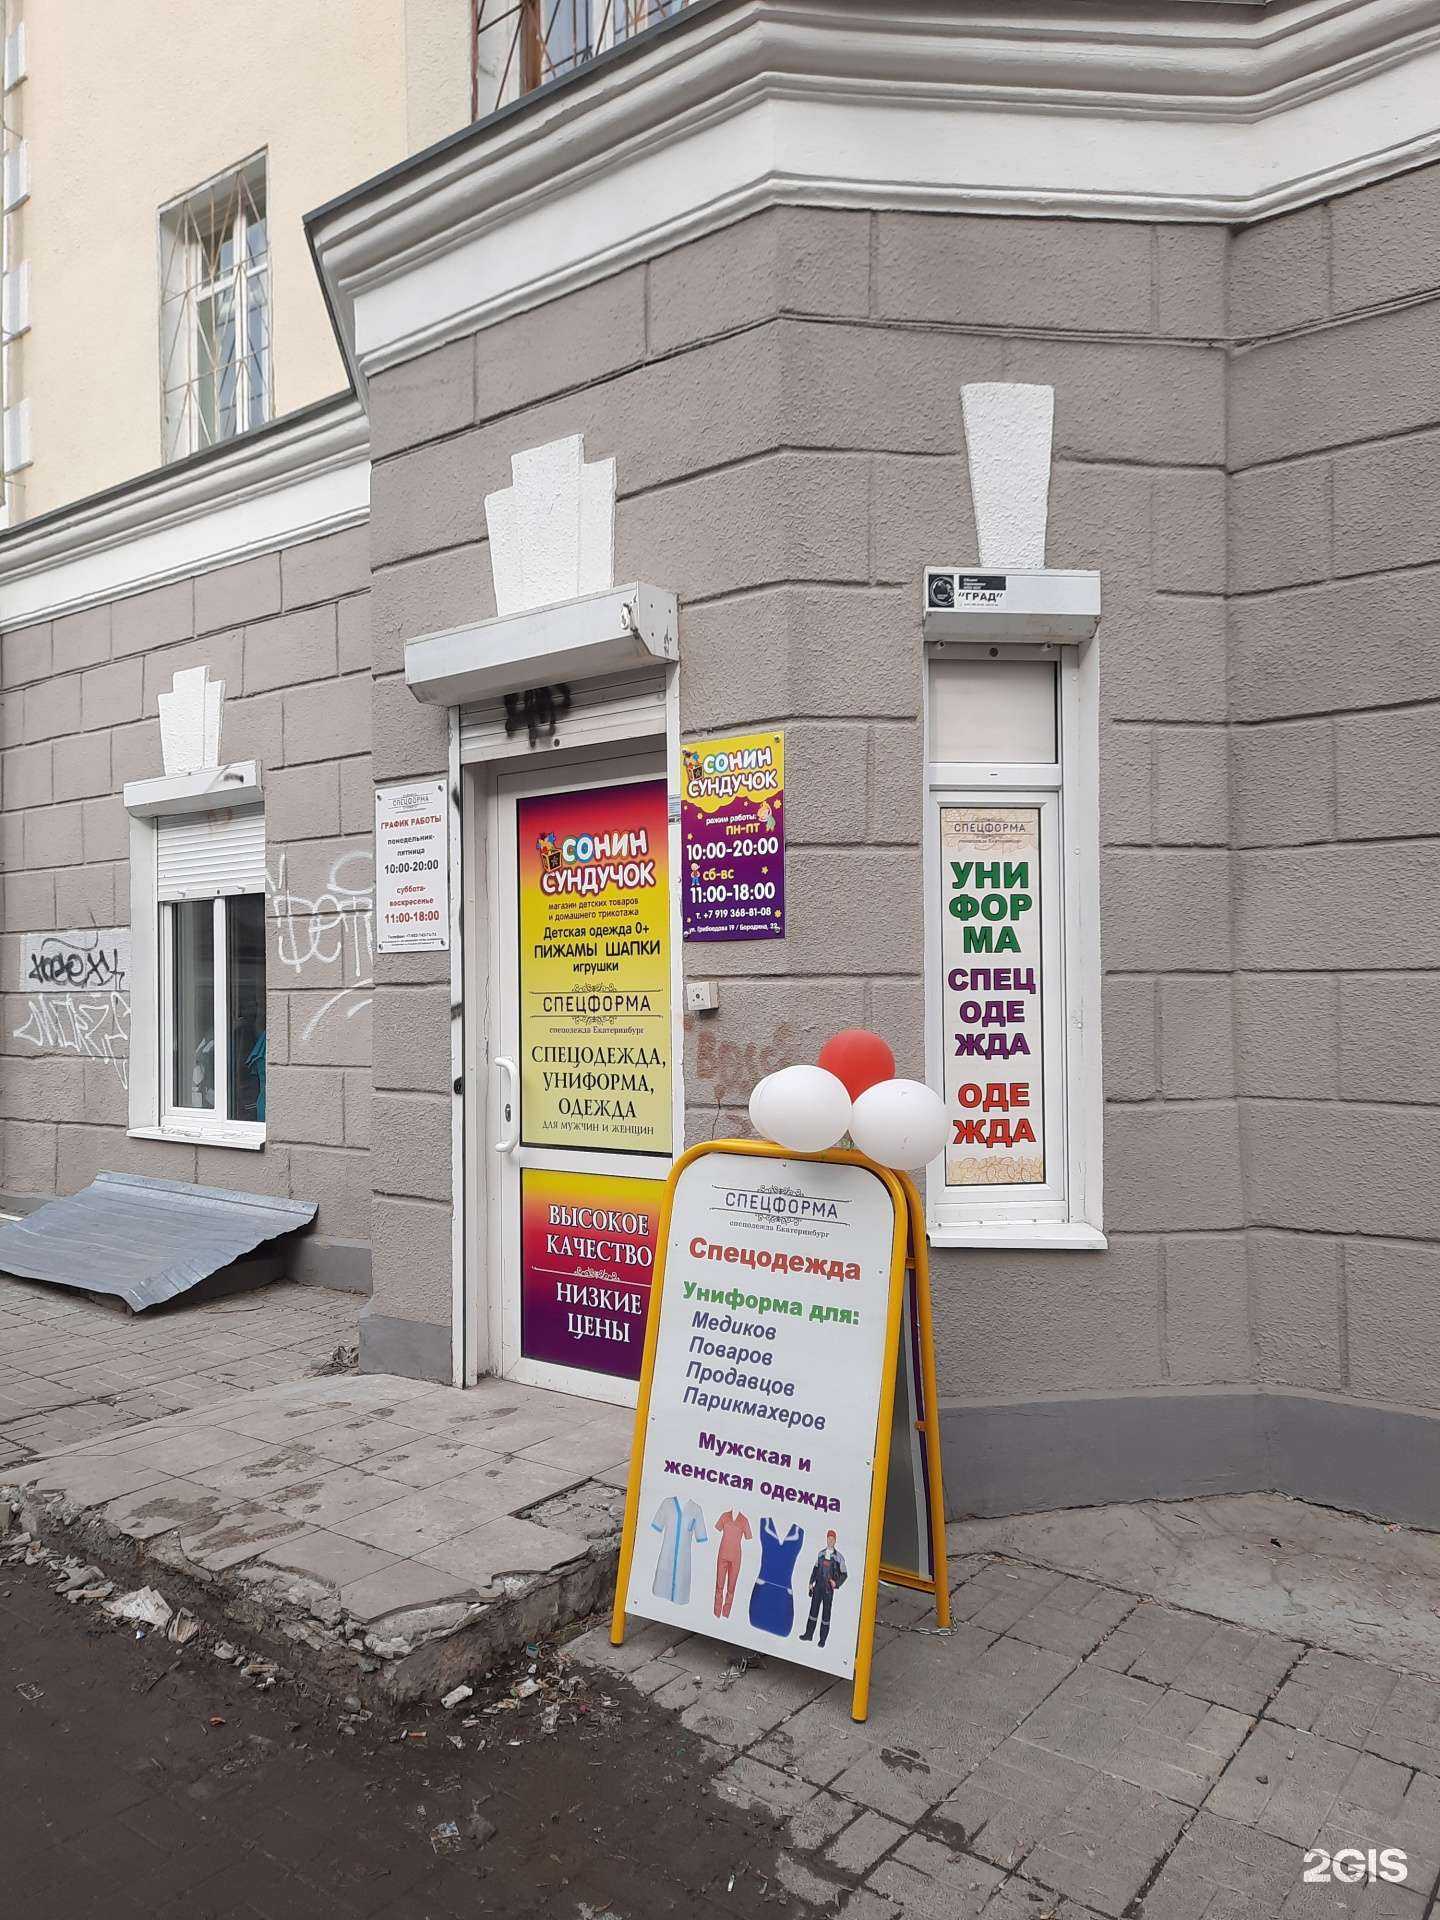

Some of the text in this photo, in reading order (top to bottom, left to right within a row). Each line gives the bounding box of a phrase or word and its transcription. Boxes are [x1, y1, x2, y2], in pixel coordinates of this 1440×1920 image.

[703, 746, 772, 774] СОНИН
[688, 769, 778, 797] СУНДУЧОК
[381, 815, 442, 830] ГРАФИК РАБОТЫ
[706, 813, 757, 826] режим работы:
[954, 823, 1026, 834] СПЕЦФОРМА
[397, 848, 425, 858] пятница
[561, 829, 648, 863] СОНИН
[686, 837, 778, 861] 10:00-20:00
[384, 859, 439, 875] 10:00-20:00
[542, 861, 655, 895] СУНДУЧОК
[702, 867, 734, 881] сб-вс
[949, 862, 1029, 890] УНИ
[389, 898, 434, 908] воскресенье
[397, 884, 426, 895] суббота-
[690, 882, 775, 904] 11:00-18:00
[384, 910, 440, 924] 11:00-18:00
[548, 898, 638, 911] магазин детских товаров
[555, 911, 596, 922] домашнего
[598, 908, 639, 920] трикотажа
[704, 910, 713, 918] +7
[715, 909, 728, 918] 919
[730, 907, 771, 918] 368-81-08
[948, 893, 1033, 921] ФОР
[544, 922, 650, 941] Детская одежда 0+
[963, 926, 1021, 954] МА
[534, 940, 661, 959] ПИЖАМЫ ШАПКИ
[573, 962, 619, 975] игрушки
[948, 968, 1036, 995] СПЕЦ
[543, 994, 651, 1014] СПЕЦФОРМА
[959, 1000, 1025, 1027] ОДЕ
[592, 1026, 644, 1036] Екатеринбург
[531, 1045, 666, 1068] СПЕЦОДЕЖДА,
[955, 1032, 1031, 1060] ЖДА
[542, 1071, 655, 1094] УНИФОРМА,
[558, 1098, 637, 1120] ОДЕЖДА
[958, 1083, 1030, 1113] ОДЕ
[560, 1121, 599, 1132] МУЖЧИН
[611, 1124, 654, 1136] ЖЕНЩИН
[953, 1118, 1037, 1148] ЖДА
[725, 1192, 838, 1219] СПЕЦФОРМА
[548, 1204, 649, 1236] ВЫСОКОЕ
[729, 1220, 830, 1239] спецодежда Екатеринбург
[546, 1234, 653, 1267] КАЧЕСТВО
[689, 1237, 862, 1282] Спецодежда
[556, 1281, 642, 1315] НИЗКИЕ
[682, 1280, 860, 1325] Униформа для:
[568, 1312, 630, 1343] ЦЕНЫ
[691, 1311, 777, 1341] Медиков
[689, 1335, 773, 1366] Поваров
[686, 1360, 795, 1397] Продавцов
[683, 1386, 826, 1431] Парикмахеров
[698, 1432, 812, 1473] Мужская и
[664, 1458, 841, 1513] женская одежда
